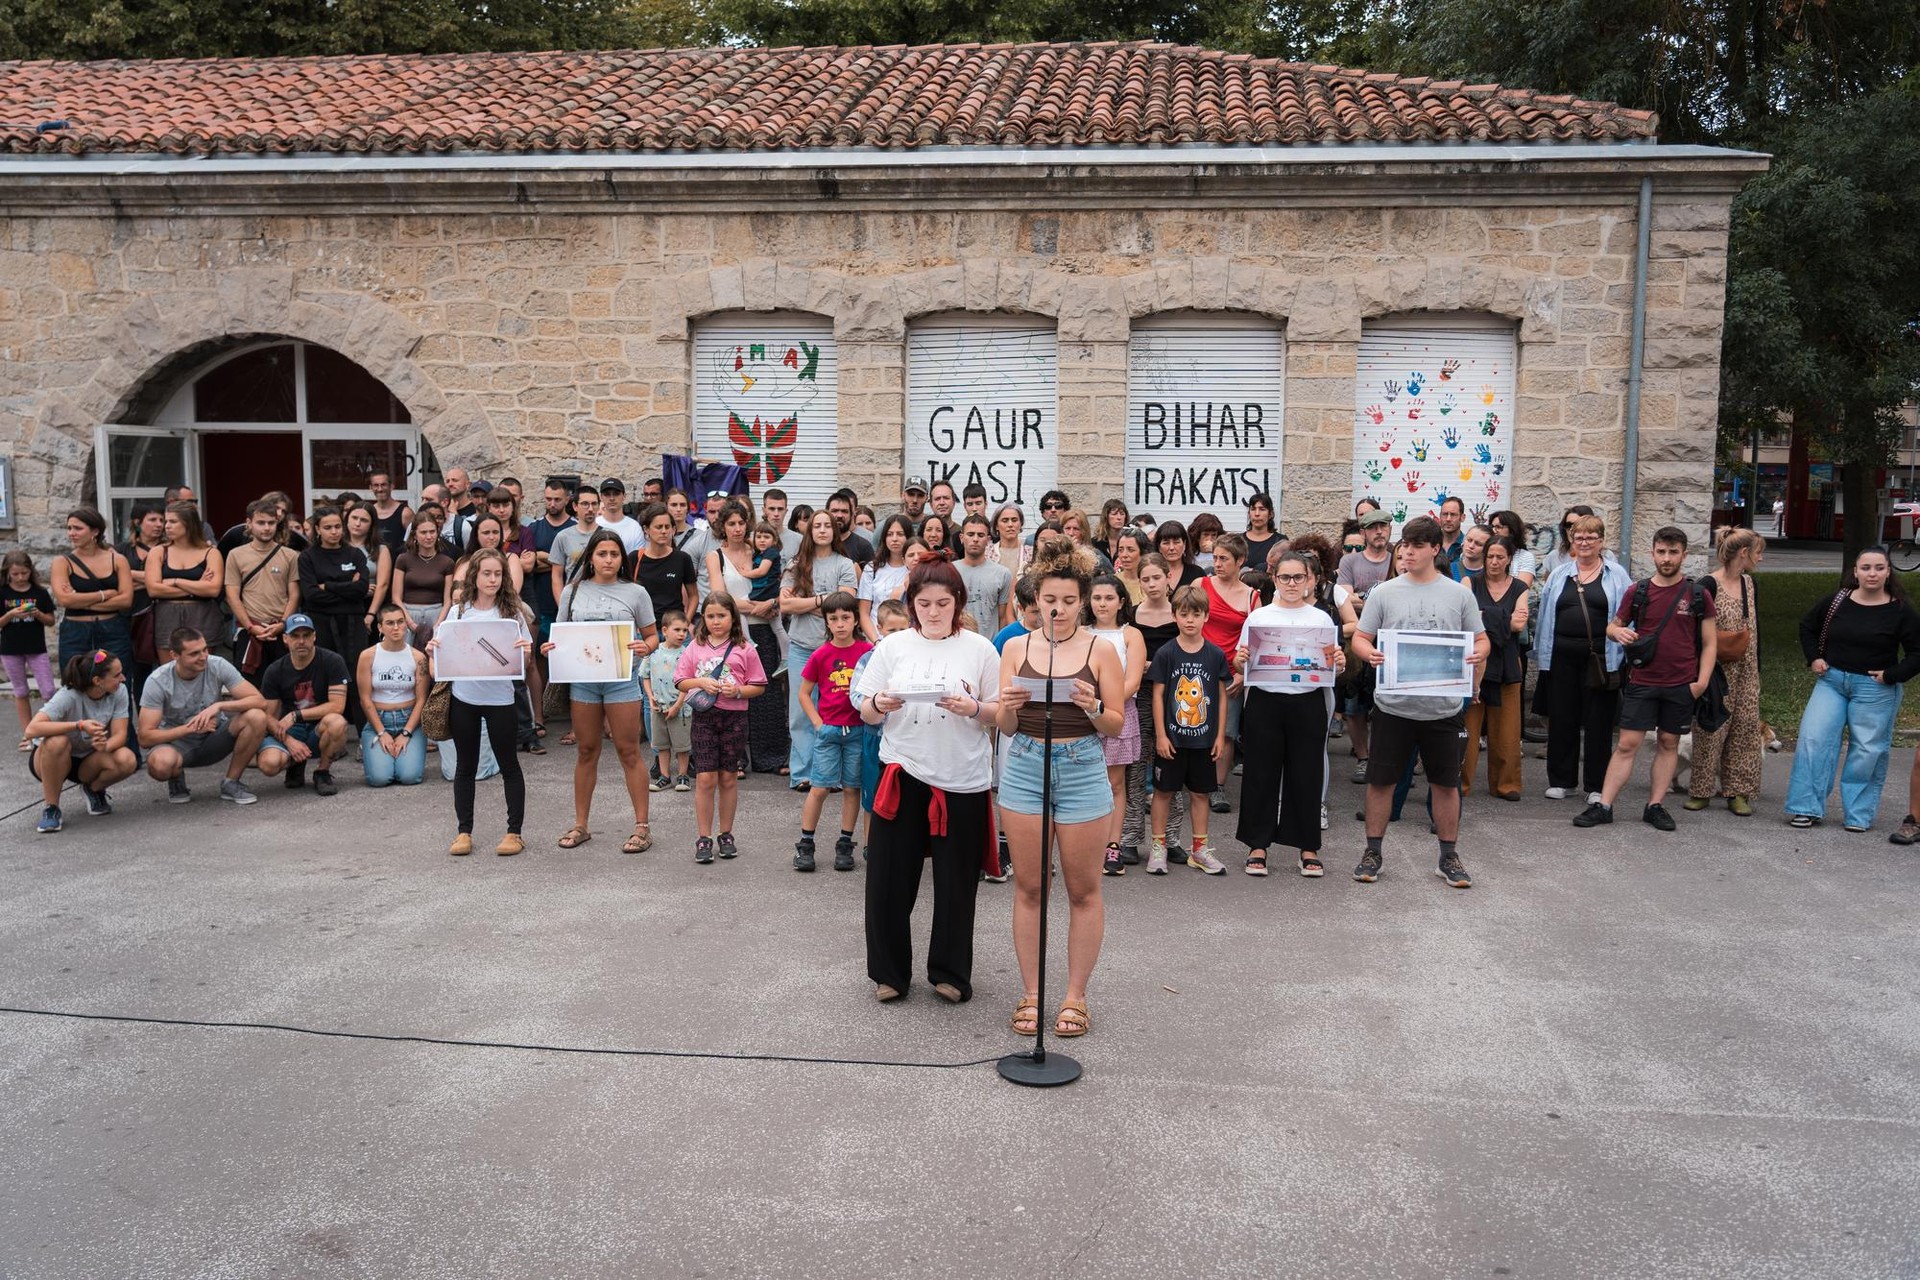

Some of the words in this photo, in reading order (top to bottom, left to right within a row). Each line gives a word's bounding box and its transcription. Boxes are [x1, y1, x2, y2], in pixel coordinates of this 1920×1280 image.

[929, 405, 1044, 453] GAUR
[1144, 402, 1265, 450] BIHAR
[1134, 467, 1269, 507] IRAKATSI
